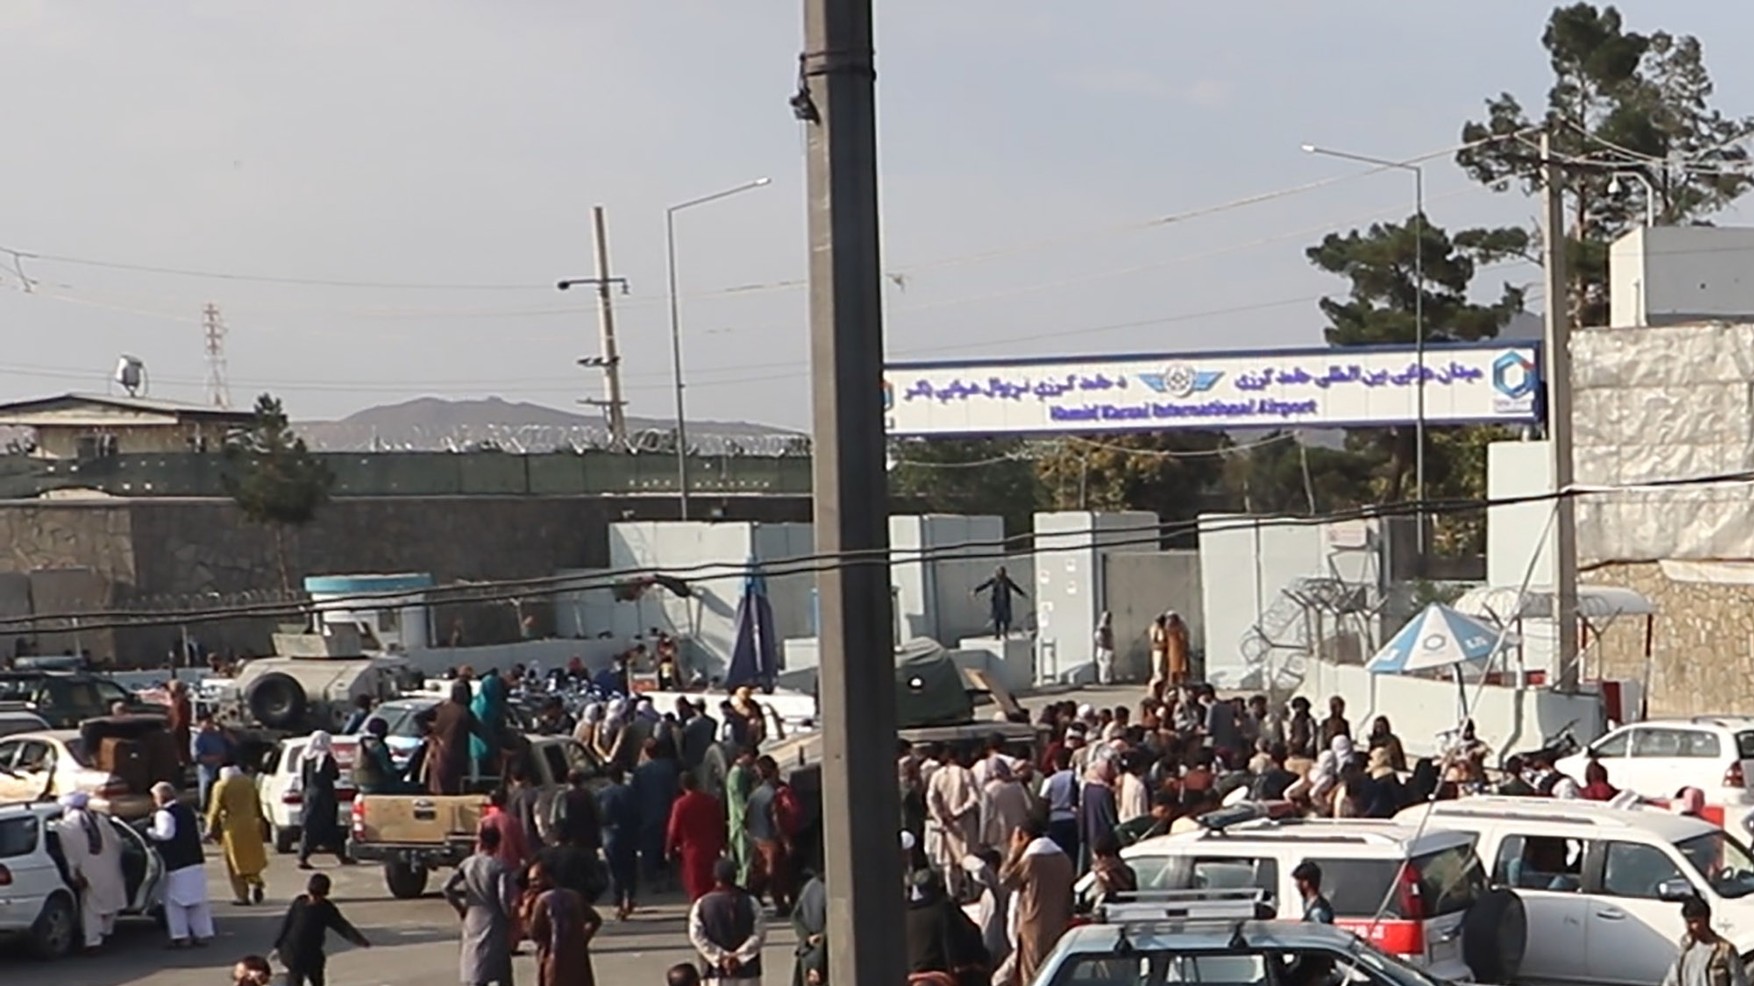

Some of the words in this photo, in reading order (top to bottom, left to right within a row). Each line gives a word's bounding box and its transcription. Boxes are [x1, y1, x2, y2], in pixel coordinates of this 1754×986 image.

[1050, 405, 1099, 422] Hamid
[1152, 400, 1255, 419] International
[1257, 399, 1317, 419] Airport
